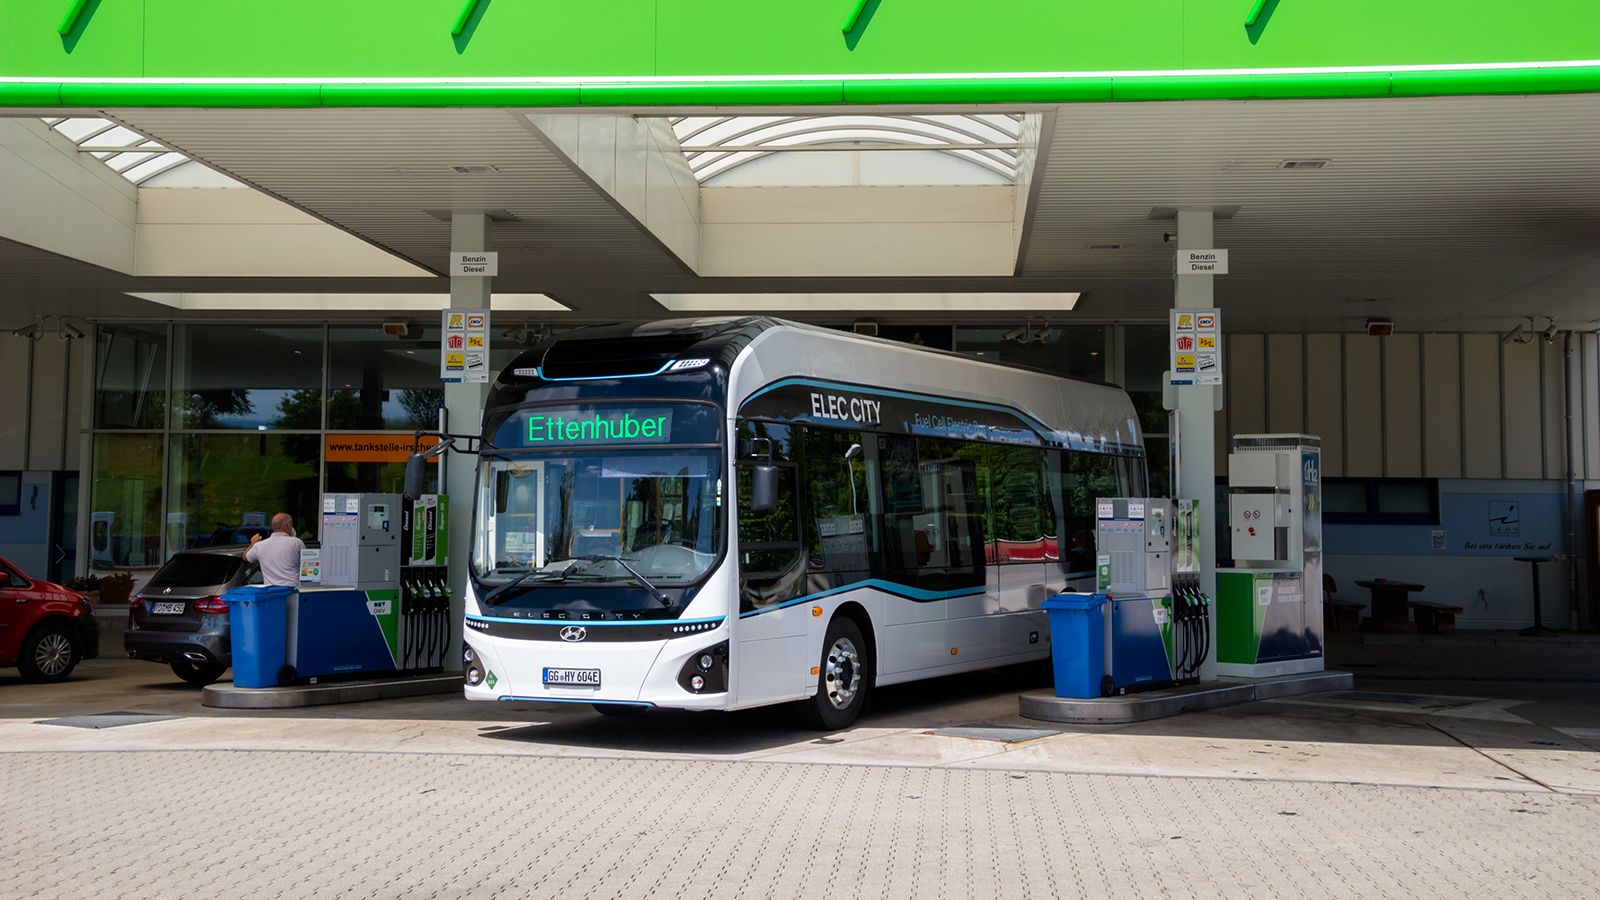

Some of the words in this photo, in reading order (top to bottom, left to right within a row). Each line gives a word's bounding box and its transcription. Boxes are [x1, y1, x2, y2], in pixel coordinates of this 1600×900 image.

[448, 336, 464, 349] UTA
[1178, 337, 1193, 350] UTA
[811, 393, 848, 421] ELEC
[850, 398, 880, 424] CITY
[528, 412, 667, 441] Ettenhuber
[914, 413, 931, 428] Fuel
[932, 416, 945, 429] Cell
[548, 670, 559, 681] GG
[564, 671, 575, 682] HY
[577, 671, 598, 682] 604E
